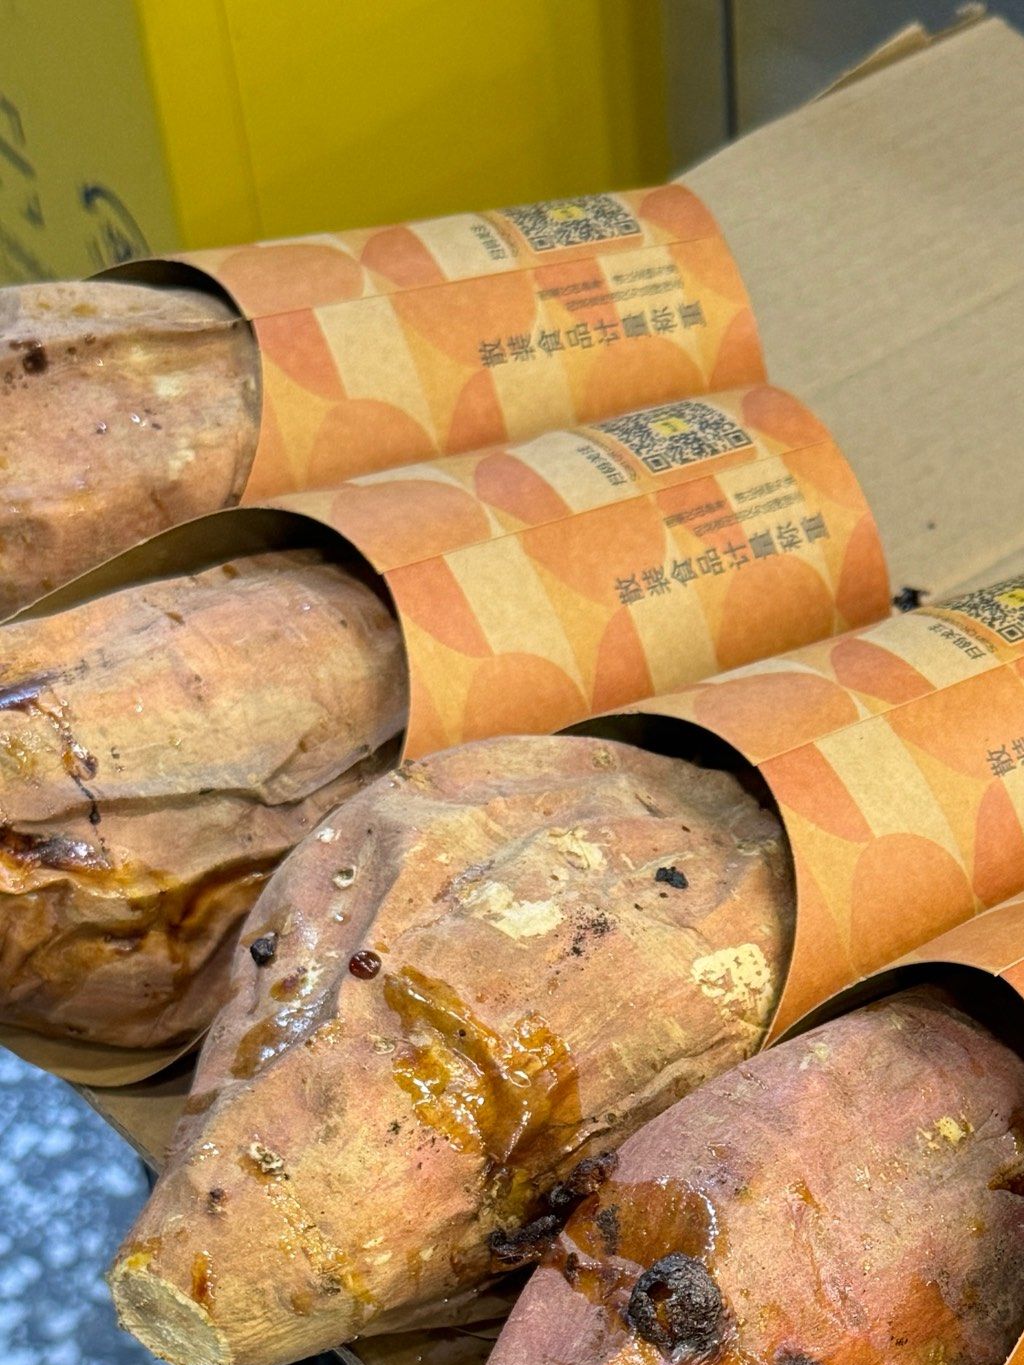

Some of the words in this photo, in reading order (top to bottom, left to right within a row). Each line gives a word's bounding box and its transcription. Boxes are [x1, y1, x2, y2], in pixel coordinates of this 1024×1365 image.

[479, 299, 707, 369] 散装食品计量称重
[615, 511, 830, 606] 散装食品计量称重
